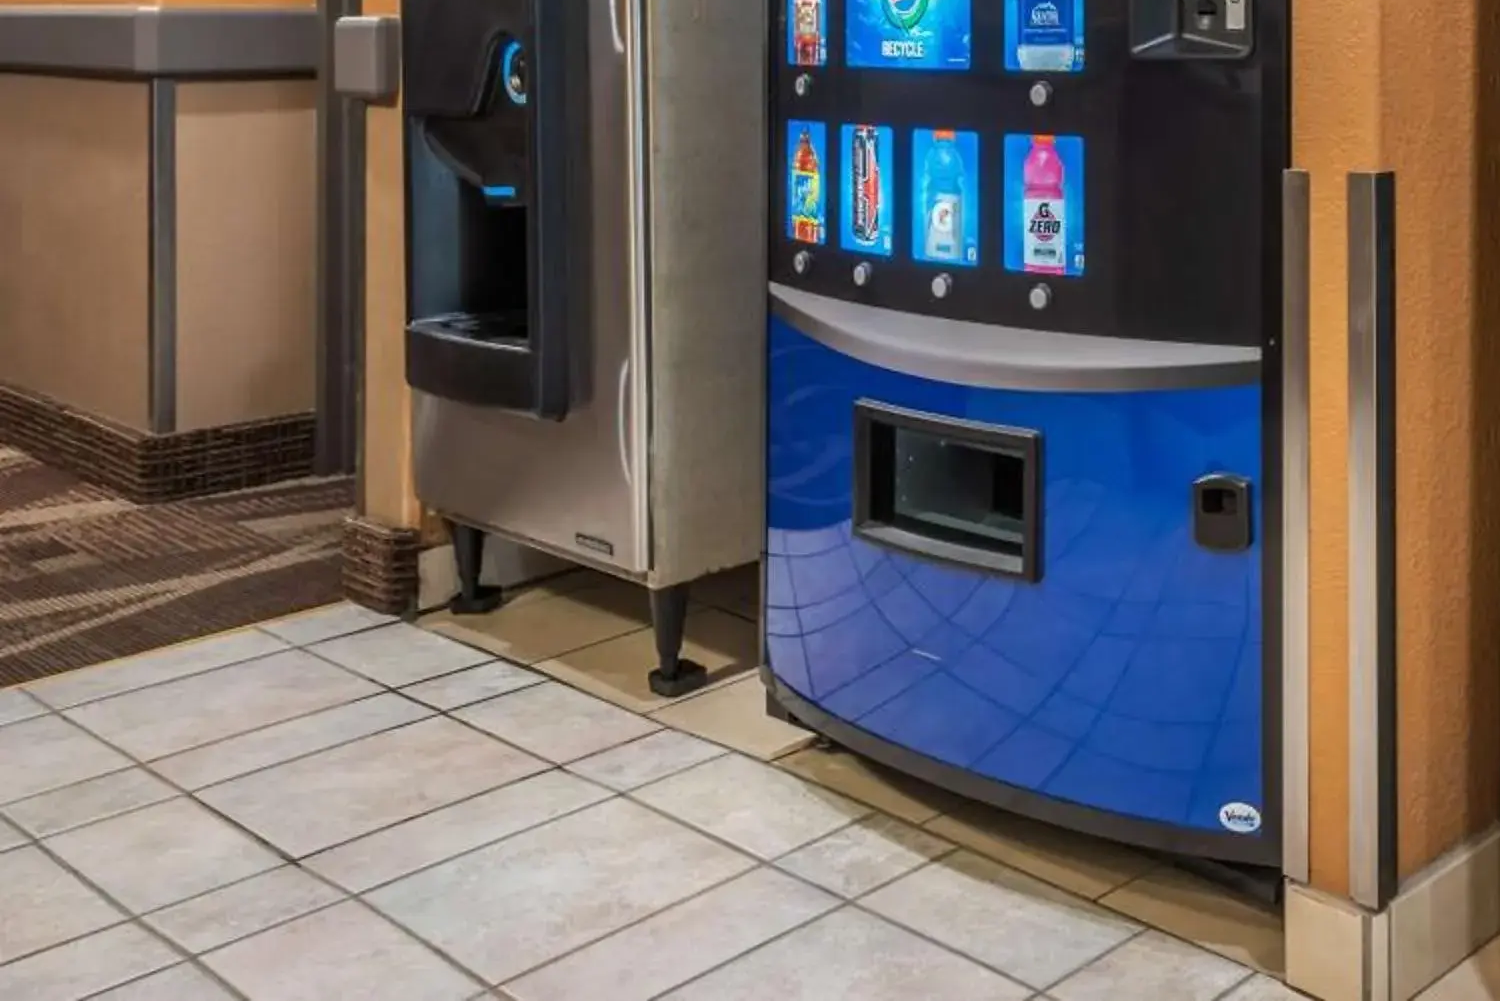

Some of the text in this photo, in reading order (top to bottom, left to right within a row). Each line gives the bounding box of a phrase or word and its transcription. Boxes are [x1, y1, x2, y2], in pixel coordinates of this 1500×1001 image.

[881, 40, 926, 58] RECYCLE
[1038, 202, 1049, 217] G
[1029, 220, 1061, 234] ZERO
